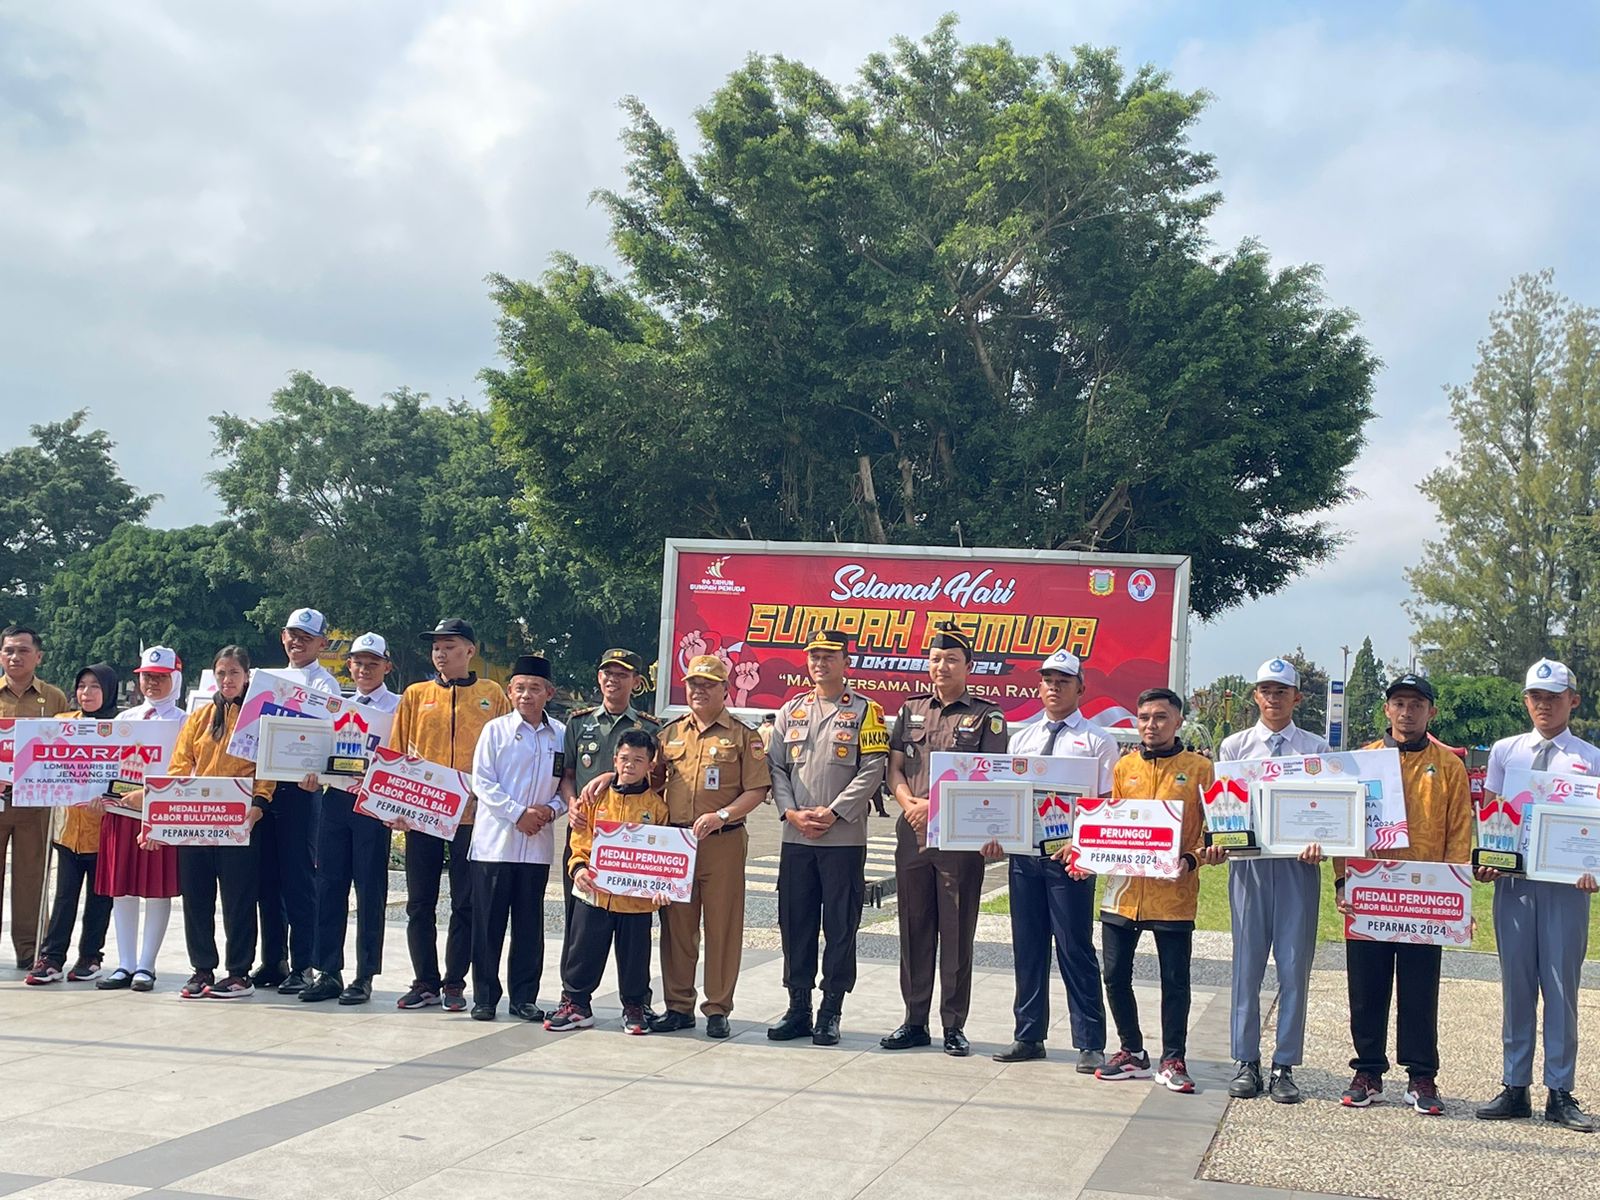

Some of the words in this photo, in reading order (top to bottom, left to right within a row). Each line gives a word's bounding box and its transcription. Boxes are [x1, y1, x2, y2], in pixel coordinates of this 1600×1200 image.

[830, 564, 942, 601] Selamat
[943, 568, 1017, 608] Hari
[746, 603, 916, 650] SUMPAH
[861, 655, 931, 671] OKTOBE
[833, 721, 859, 729] POLRI
[386, 775, 421, 793] MEDALI
[421, 786, 447, 801] EMAS
[372, 783, 405, 800] CABOR
[405, 793, 430, 808] GOAL
[430, 801, 453, 815] BALL
[168, 805, 201, 813] MEDALI
[202, 805, 227, 813] EMAS
[376, 800, 417, 820] PEPARNAS
[418, 811, 440, 826] 2024
[151, 813, 182, 822] CABOR
[183, 814, 243, 822] BULUTANGKIS
[162, 829, 205, 838] PEPARNAS
[207, 829, 230, 838] 2024
[1100, 828, 1152, 840] PERUNGGU
[600, 848, 634, 861] MEDALI
[635, 853, 686, 867] PERUNGGU
[1090, 853, 1132, 864] PEPARNAS
[1135, 854, 1157, 865] 2024
[599, 859, 621, 868] CABOR
[621, 862, 664, 873] BULUTANGKIS
[663, 866, 684, 875] PUTRA
[606, 876, 648, 889] PEPARNAS
[650, 881, 672, 891] 2024
[1355, 890, 1397, 903] MEDALI
[1399, 893, 1460, 907] PERUNGGU
[1353, 902, 1380, 911] CABOR
[1380, 904, 1431, 914] BULUTANGKIS
[1432, 909, 1462, 917] BEREGU
[1367, 921, 1417, 934] PEPARNAS
[1420, 925, 1447, 935] 2024
